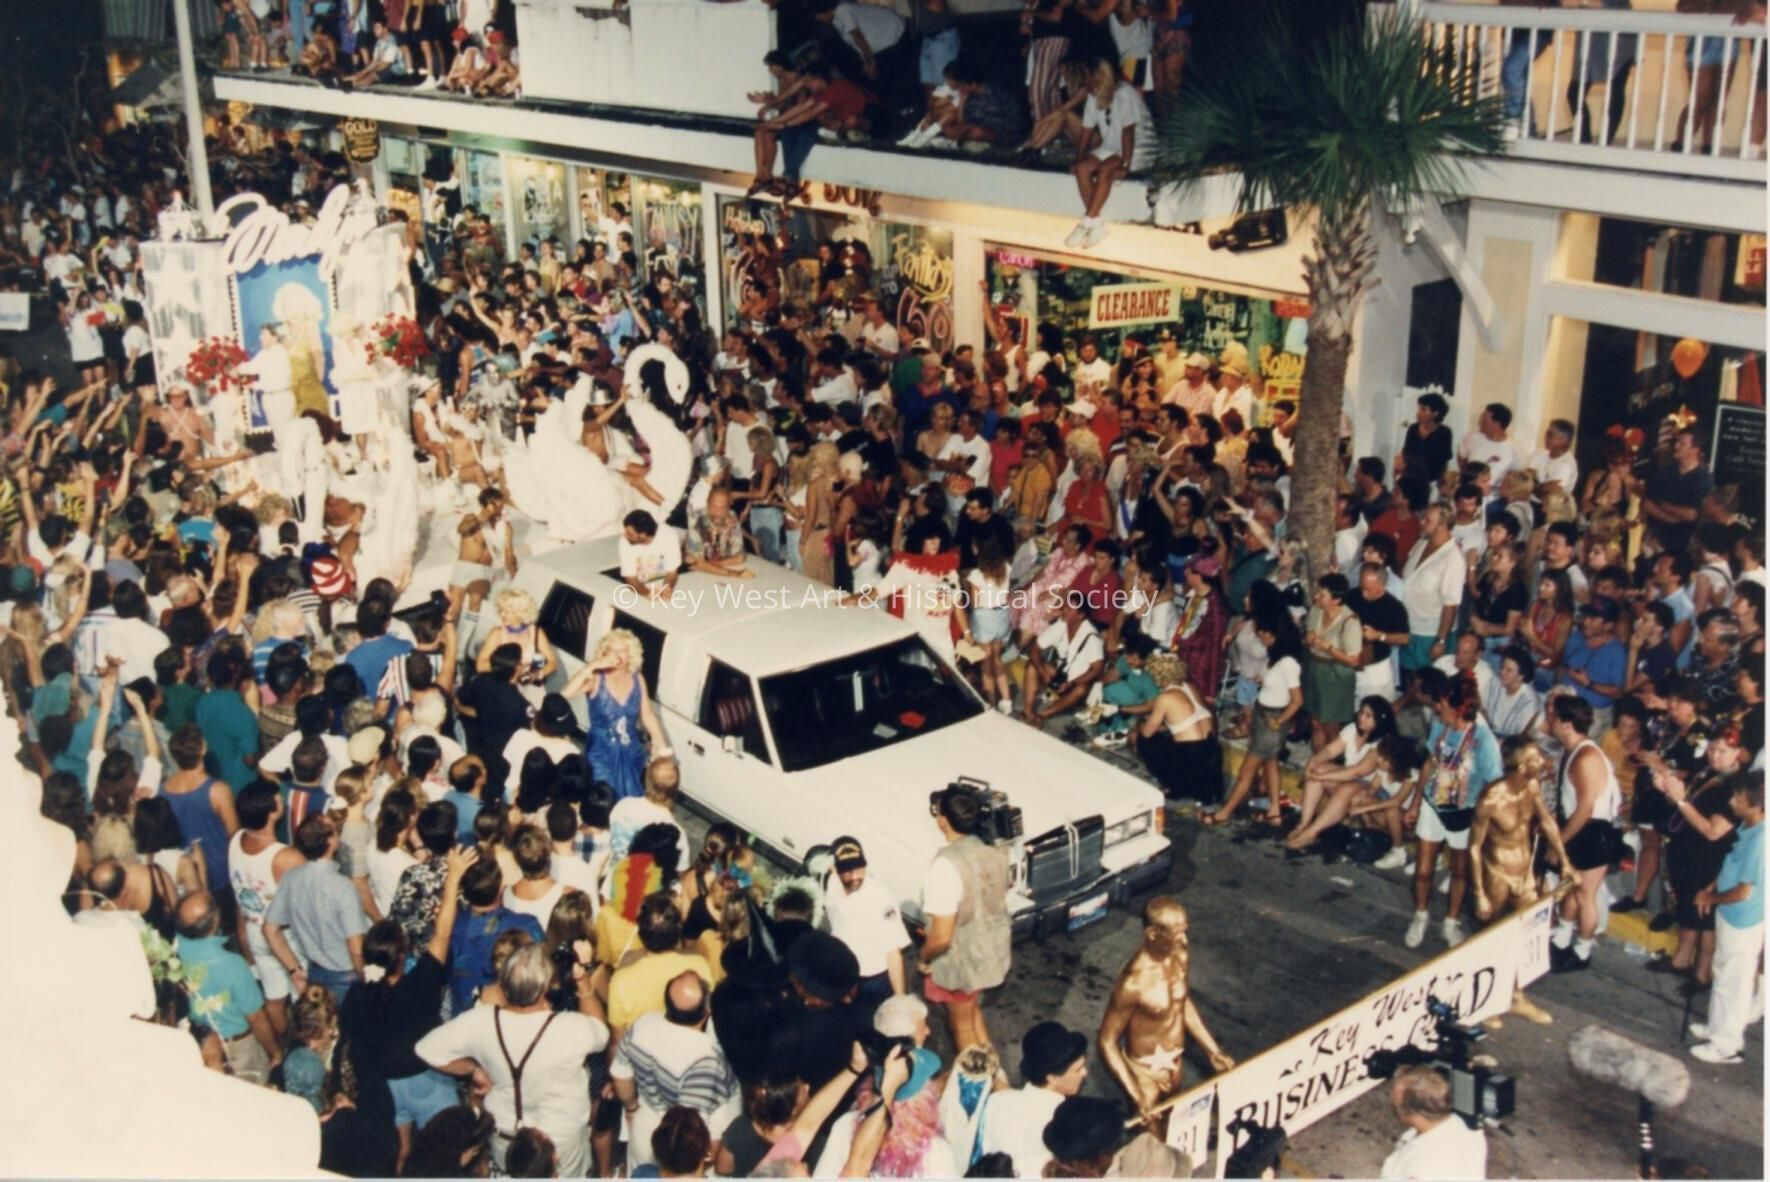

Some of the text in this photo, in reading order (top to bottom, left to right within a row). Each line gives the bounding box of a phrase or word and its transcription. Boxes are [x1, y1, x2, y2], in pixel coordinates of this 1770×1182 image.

[344, 120, 377, 135] GOLD
[1096, 288, 1172, 322] CLEARANCE
[1309, 975, 1438, 1065] Key West
